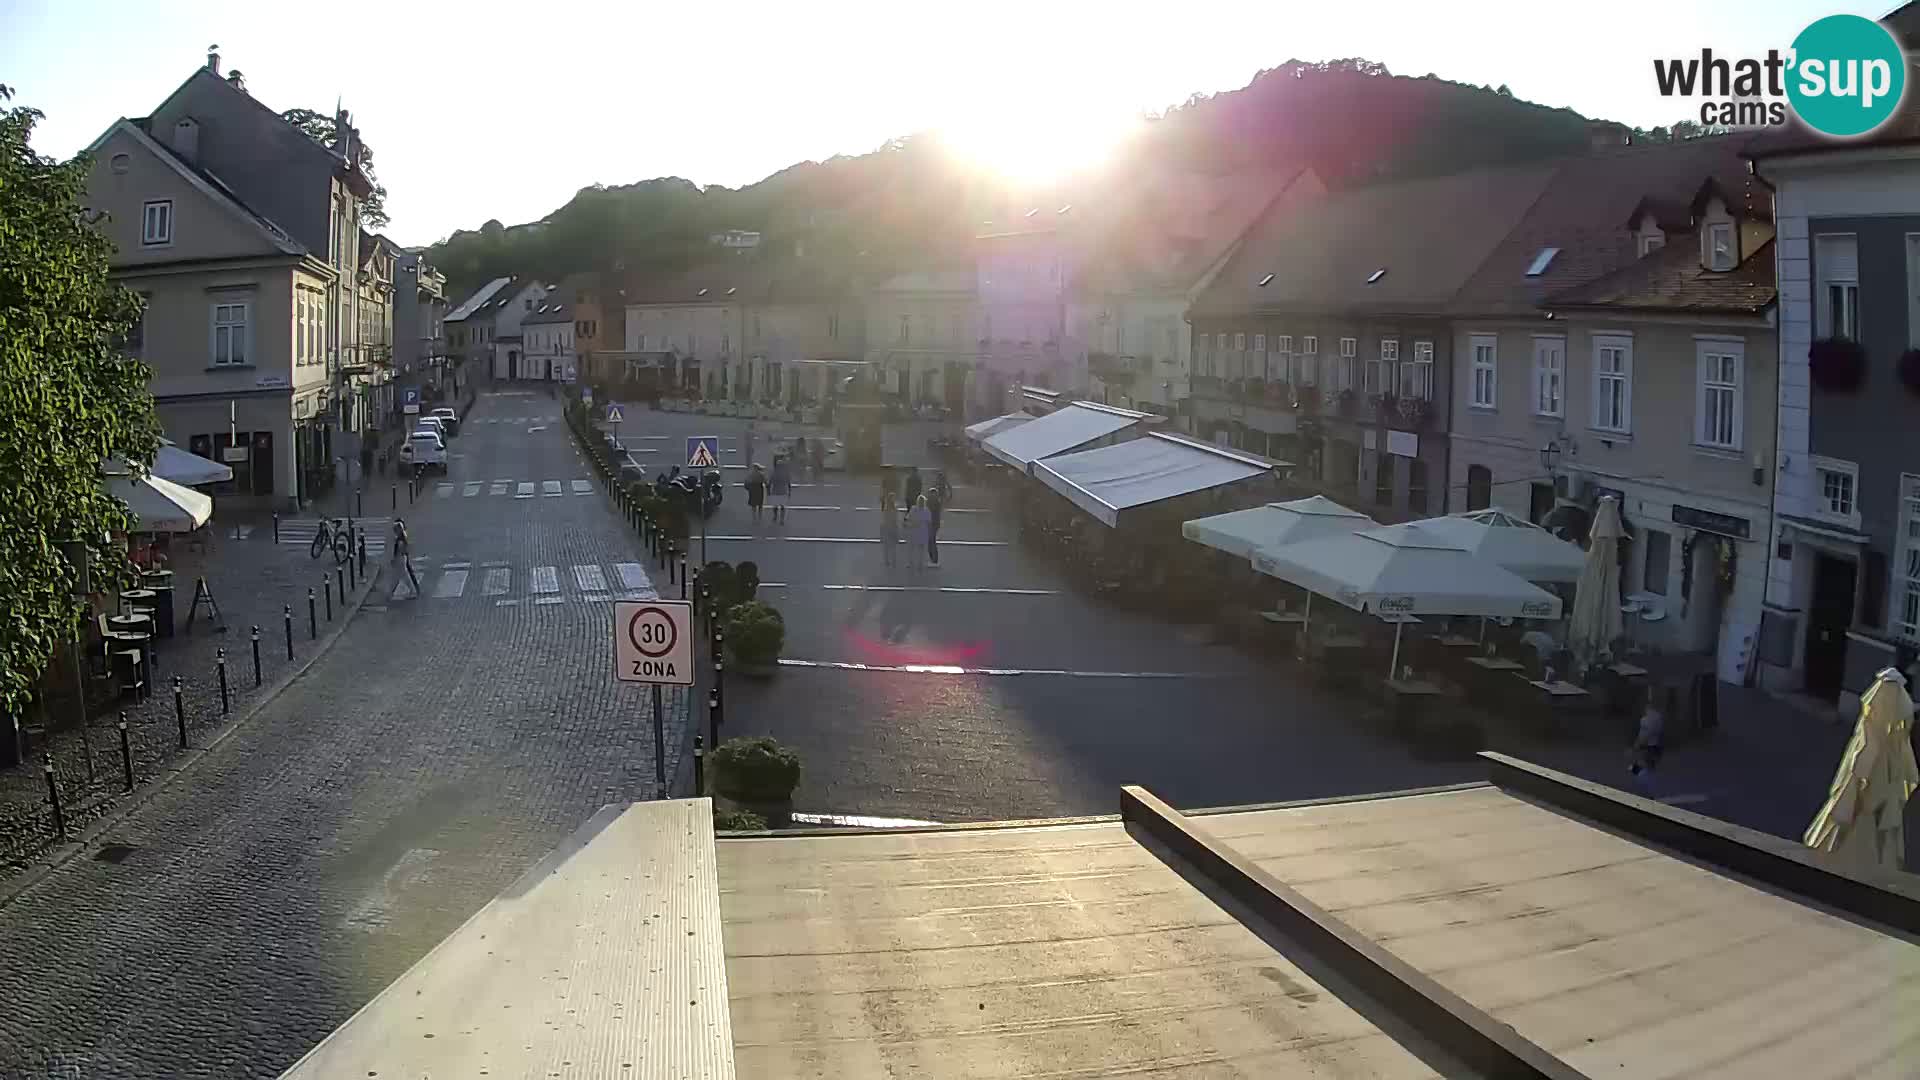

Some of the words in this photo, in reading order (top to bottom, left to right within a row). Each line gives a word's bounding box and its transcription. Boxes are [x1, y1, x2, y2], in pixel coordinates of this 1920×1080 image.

[407, 391, 416, 402] P
[641, 623, 666, 644] 30
[632, 660, 677, 677] ZONA
